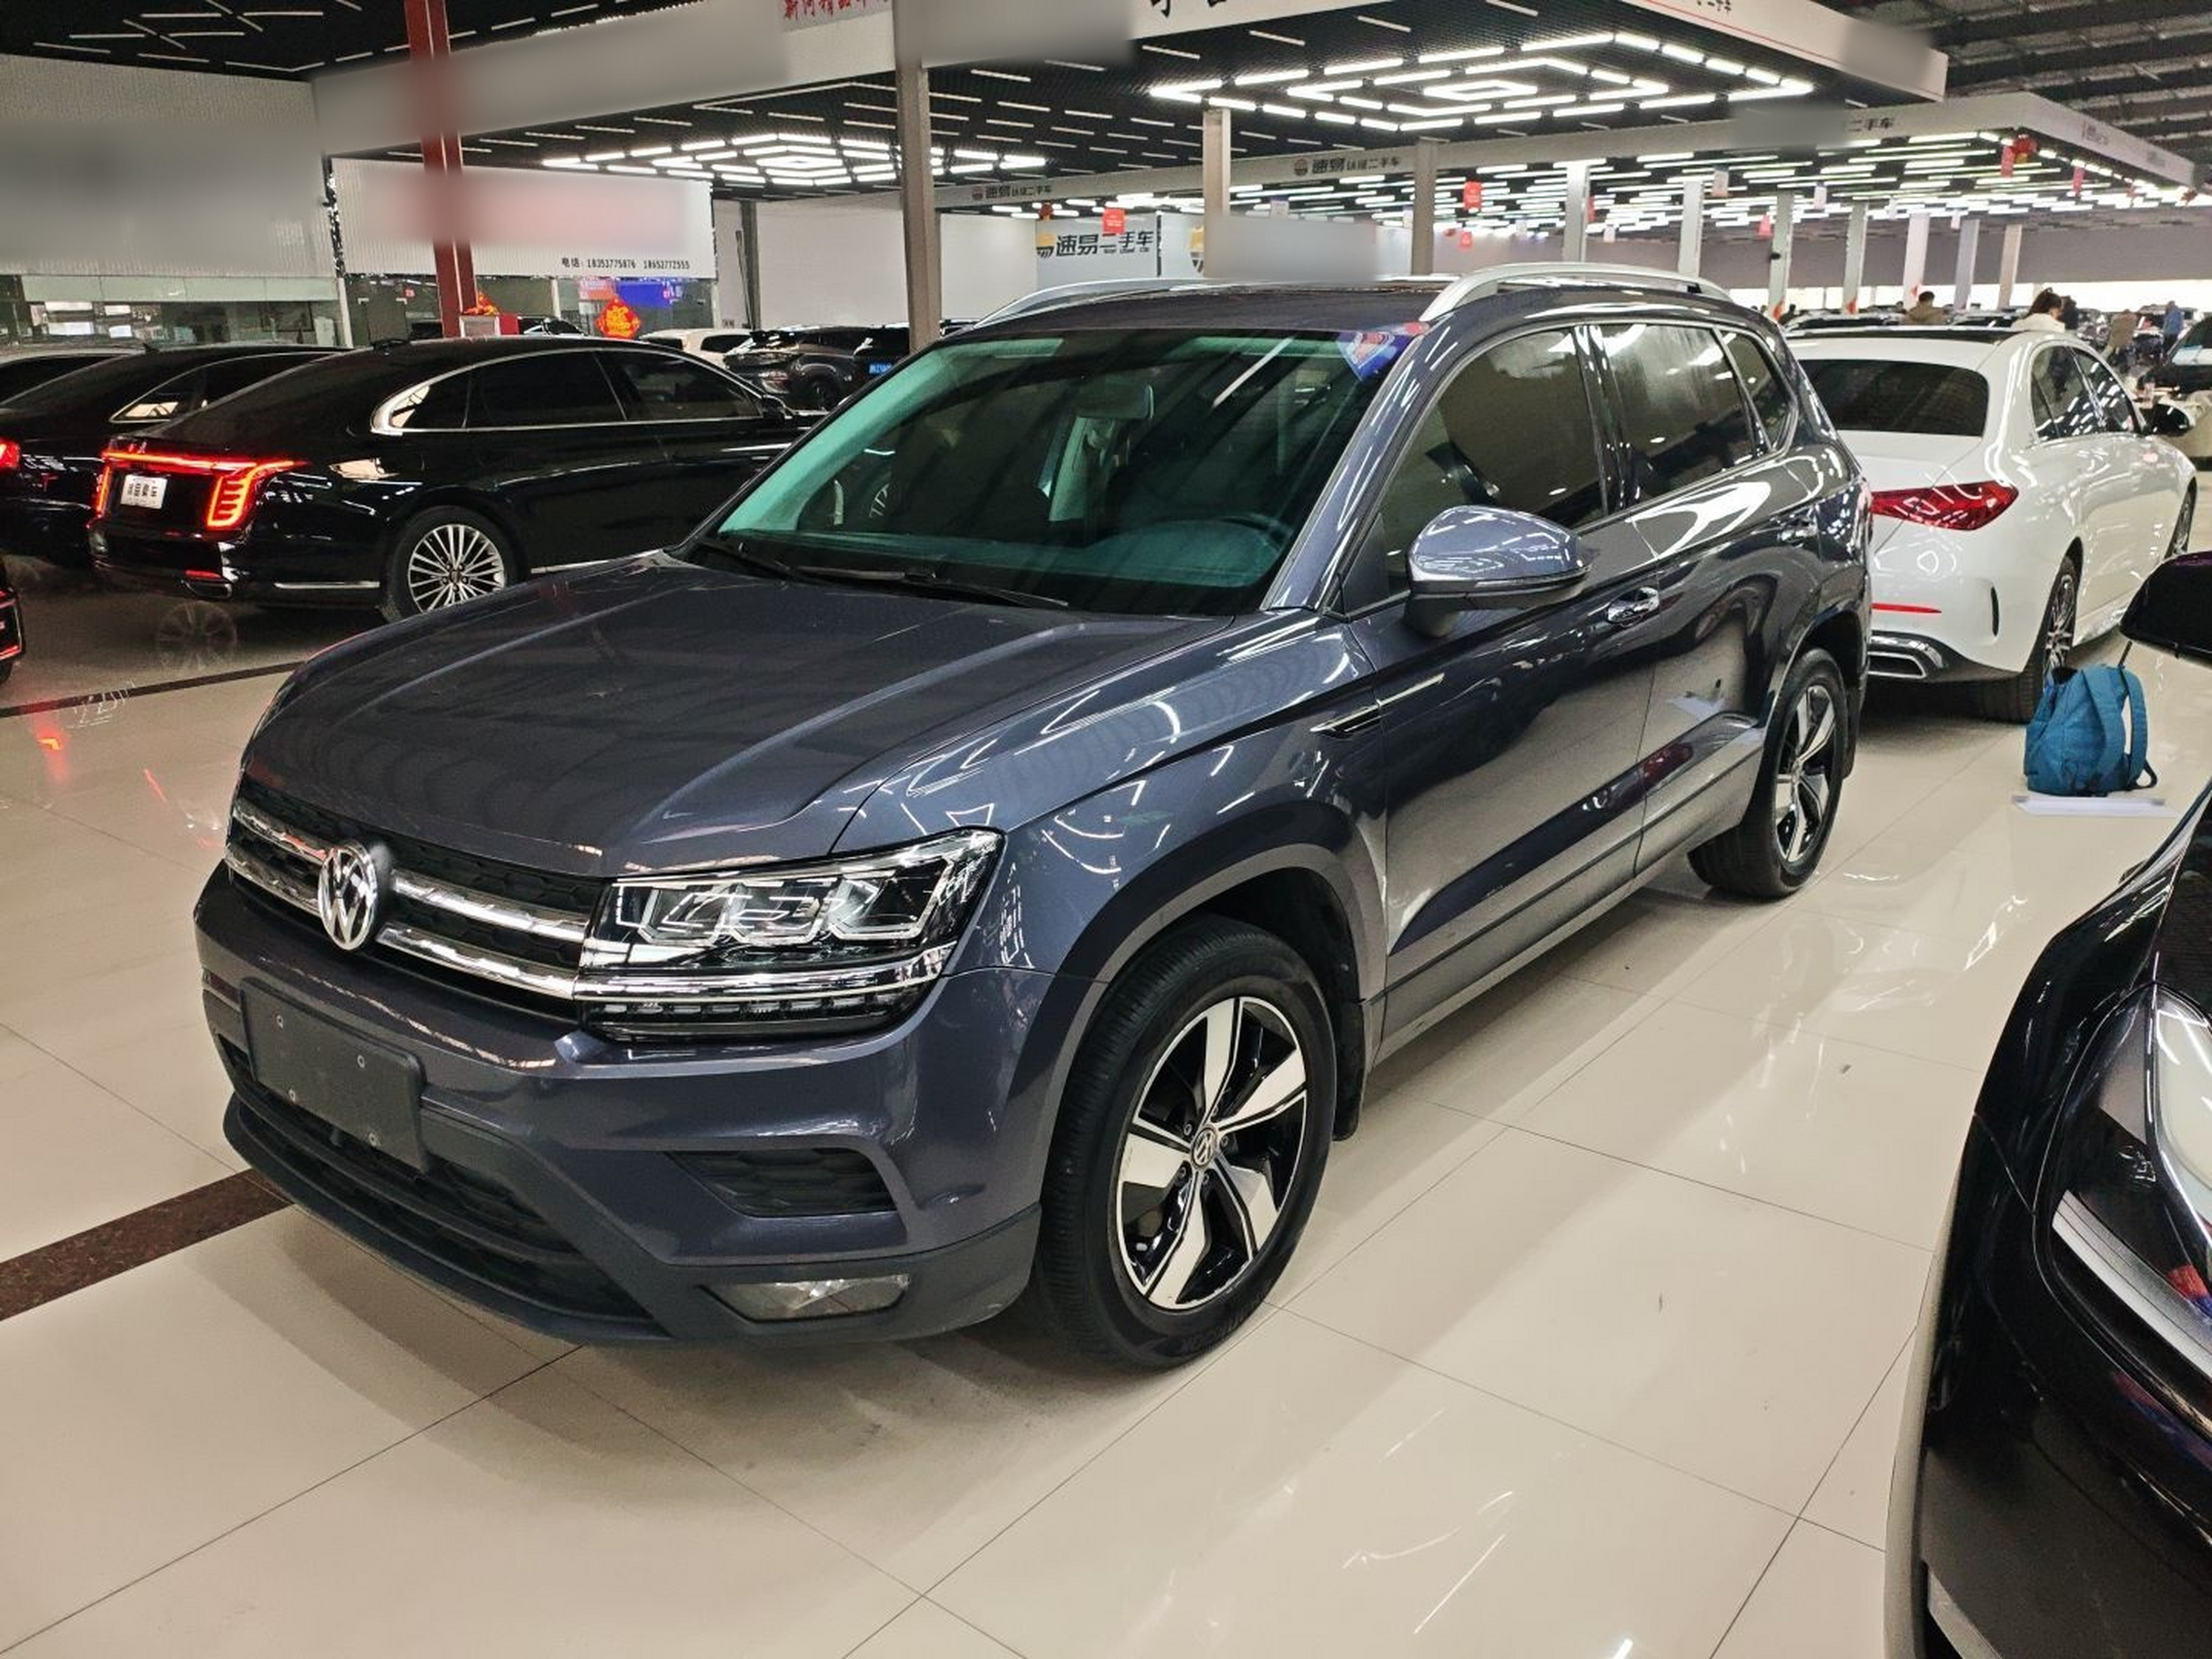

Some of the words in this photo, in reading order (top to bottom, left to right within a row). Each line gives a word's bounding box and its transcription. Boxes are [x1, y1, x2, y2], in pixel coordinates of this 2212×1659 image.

[1056, 230, 1154, 257] 速易二手车
